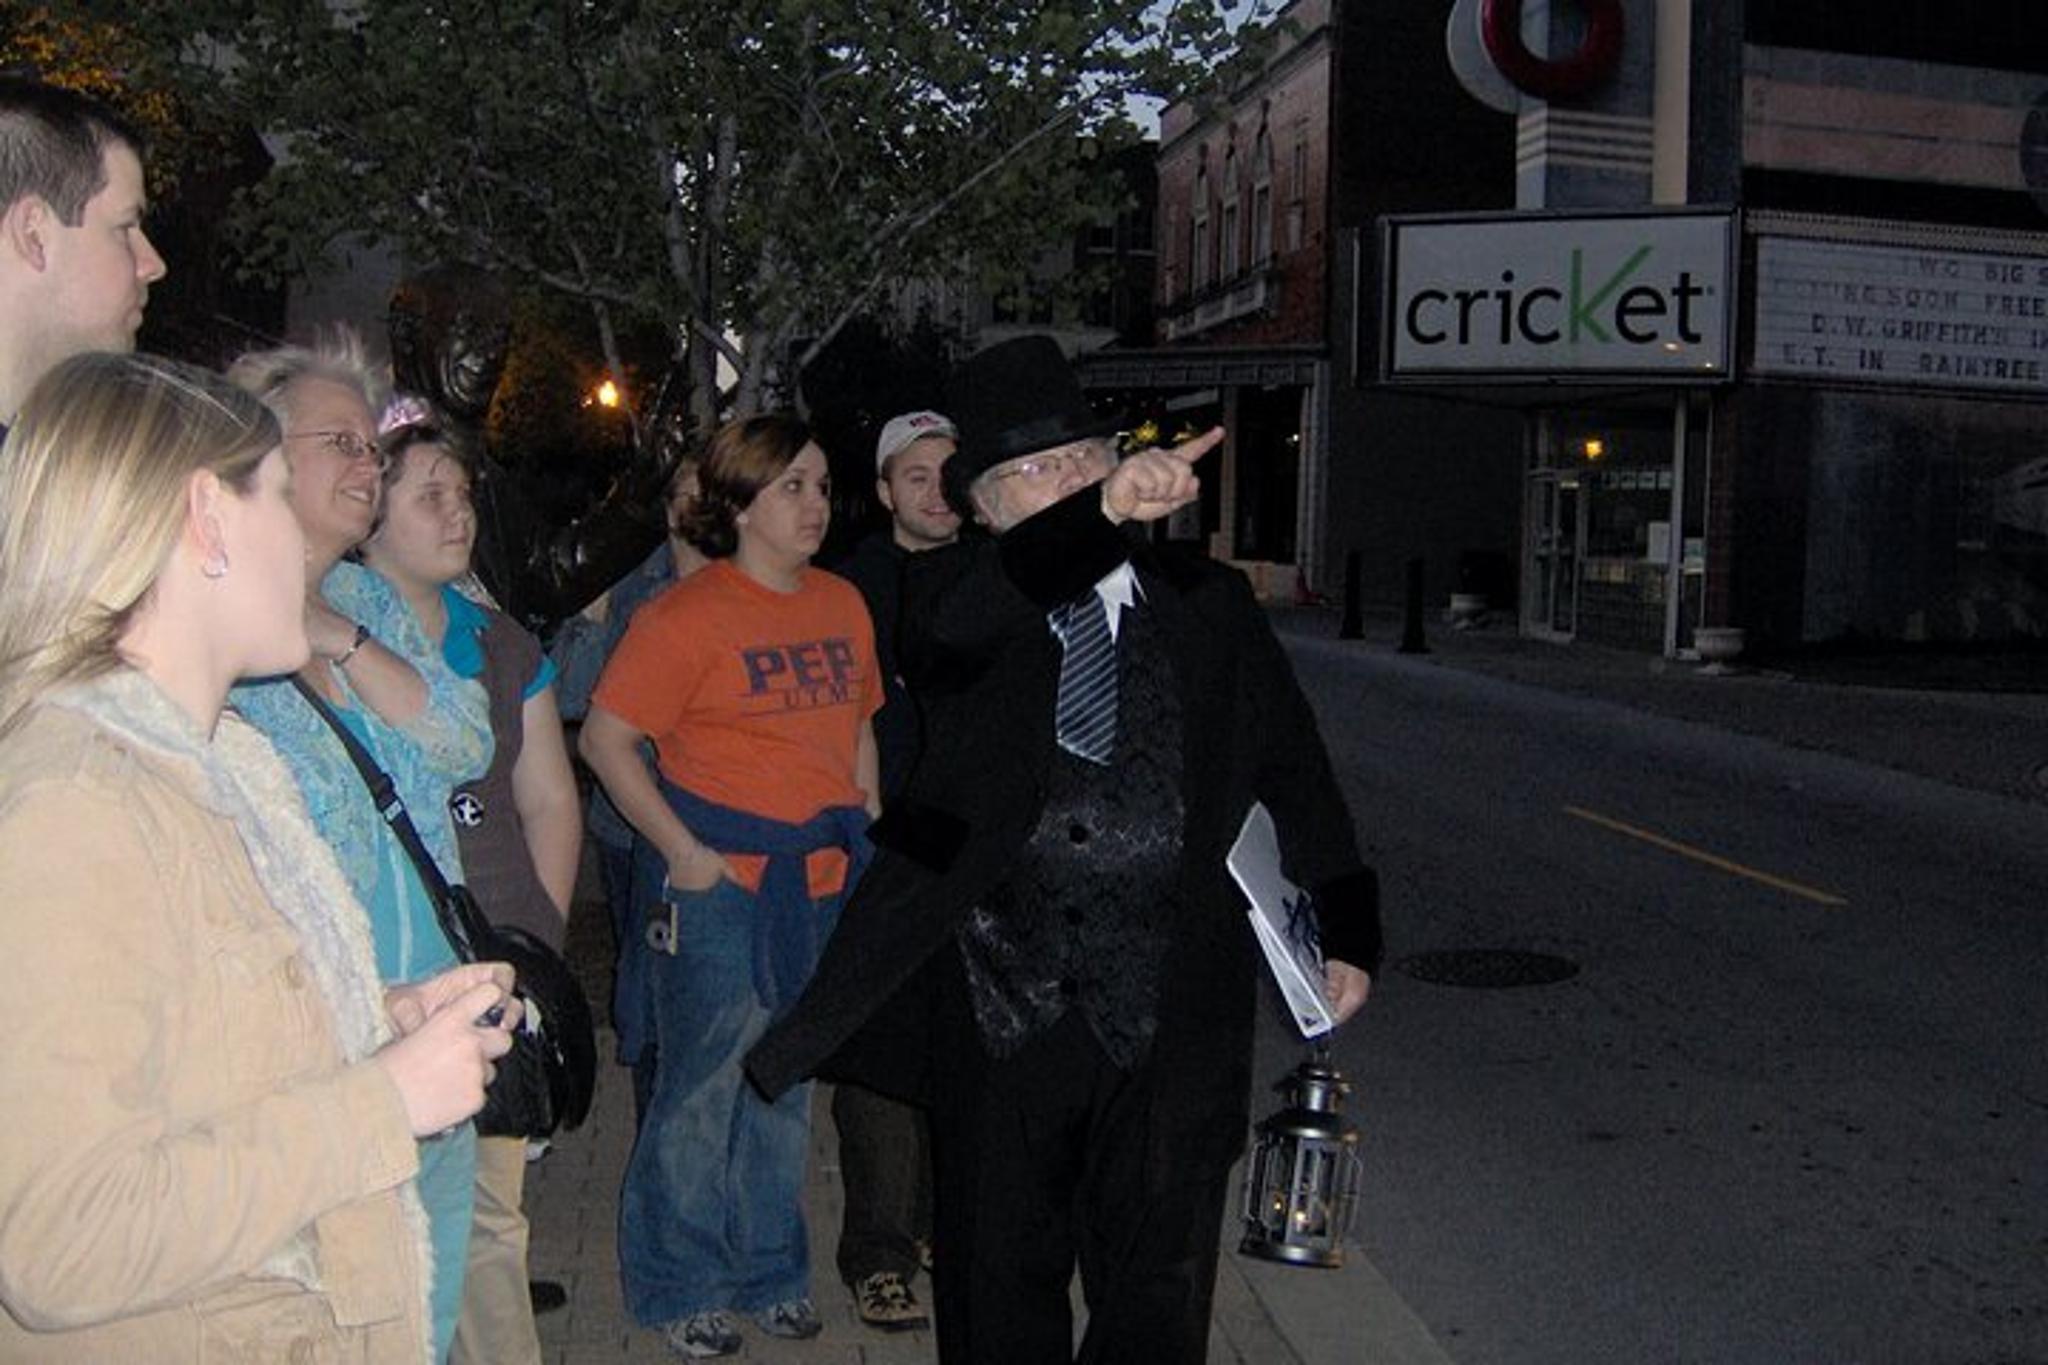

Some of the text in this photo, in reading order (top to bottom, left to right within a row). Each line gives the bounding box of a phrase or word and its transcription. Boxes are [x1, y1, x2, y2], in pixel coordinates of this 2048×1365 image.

[1984, 262, 2024, 284] BIG
[1984, 294, 2046, 317] FREE
[1859, 348, 1885, 371] IN
[1918, 352, 2041, 381] RAINTREE
